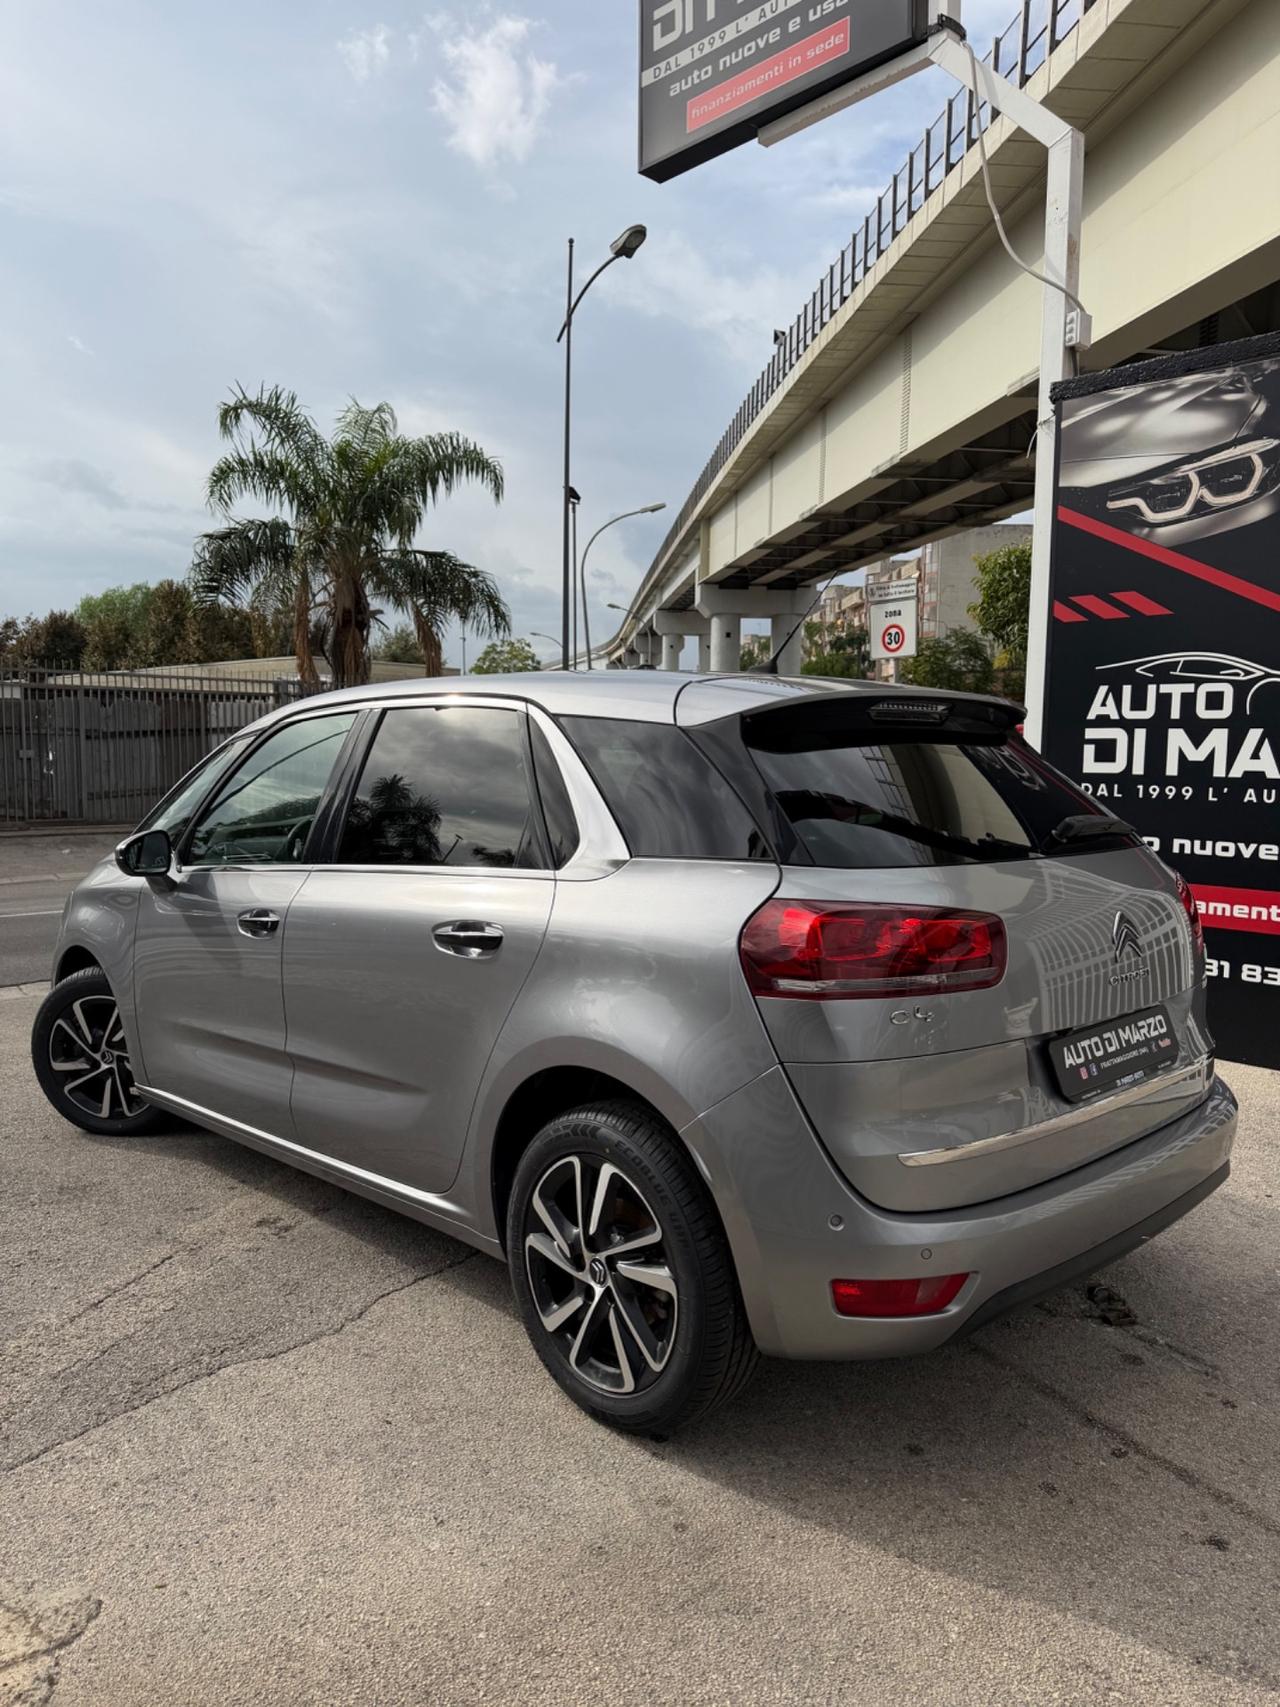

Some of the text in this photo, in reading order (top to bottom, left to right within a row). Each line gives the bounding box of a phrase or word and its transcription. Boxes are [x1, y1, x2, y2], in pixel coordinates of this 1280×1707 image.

[653, 56, 681, 80] DAL
[690, 31, 726, 59] 1999
[669, 64, 713, 97] auto
[719, 27, 781, 71] nuove
[788, 16, 801, 33] e
[691, 33, 845, 119] finanziamenti in sede
[886, 631, 901, 645] 30
[1086, 682, 1234, 720] AUTO
[1082, 727, 1147, 776] DI
[1080, 783, 1123, 798] DAL
[1136, 784, 1193, 801] 1999
[1172, 838, 1280, 861] nuove
[1063, 1014, 1168, 1069] AUTO DI MARZO
